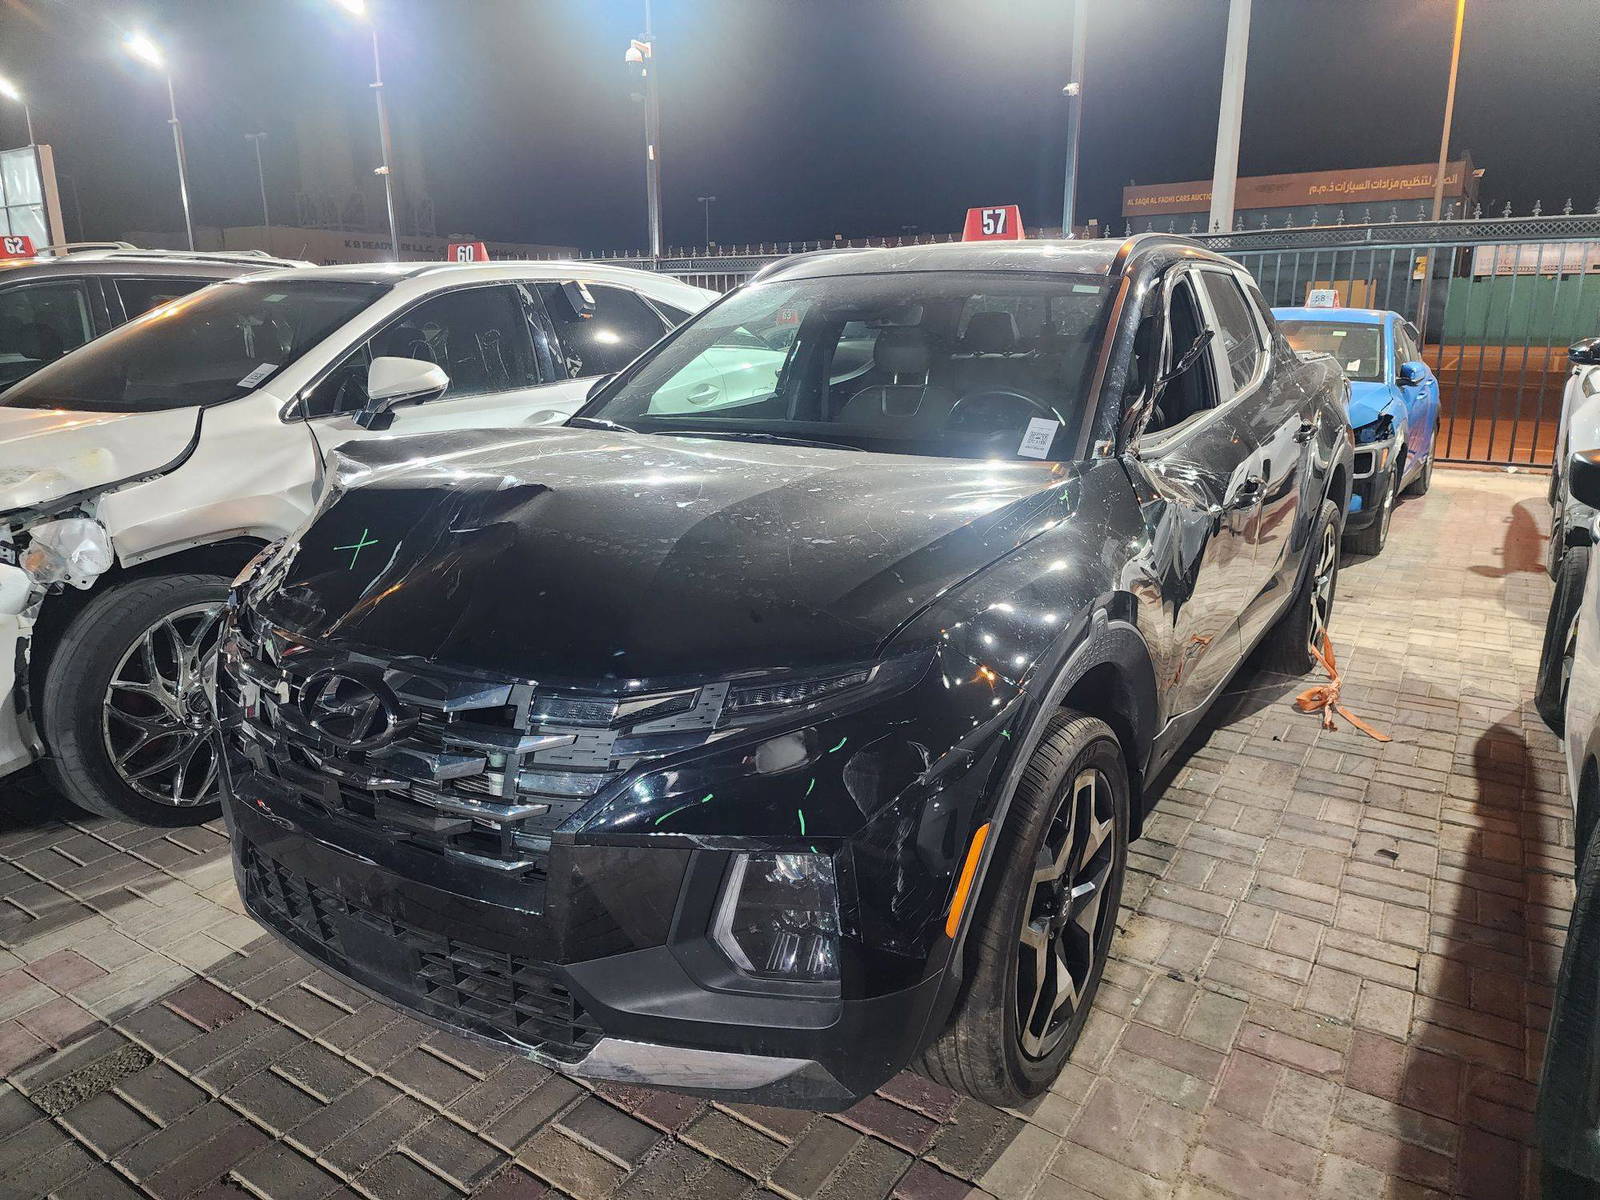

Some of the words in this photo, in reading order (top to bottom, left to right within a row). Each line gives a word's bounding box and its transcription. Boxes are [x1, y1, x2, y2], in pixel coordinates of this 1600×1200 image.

[1335, 180, 1370, 193] السيارات
[1371, 177, 1400, 191] مزادات
[1400, 175, 1432, 190] لتنظيم
[1433, 174, 1458, 187] الصر
[1135, 198, 1149, 206] SAQR
[1175, 194, 1191, 202] CARS
[1191, 193, 1213, 201] AUCTIO
[983, 208, 1006, 235] 57
[4, 237, 26, 255] 62
[457, 245, 474, 262] 60
